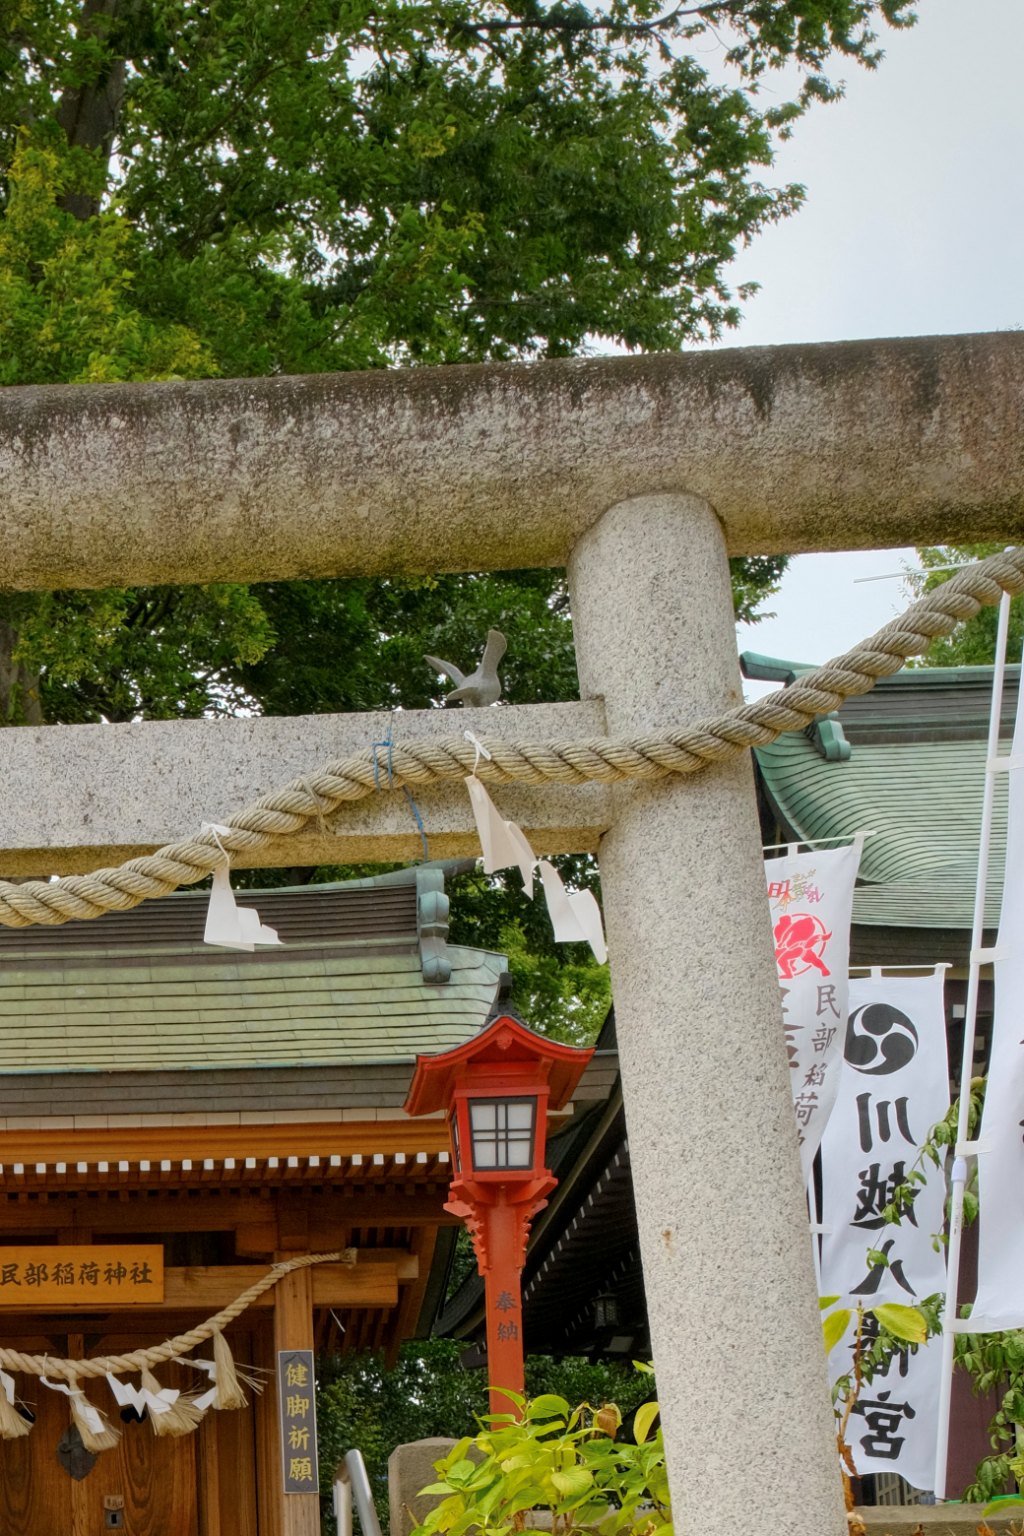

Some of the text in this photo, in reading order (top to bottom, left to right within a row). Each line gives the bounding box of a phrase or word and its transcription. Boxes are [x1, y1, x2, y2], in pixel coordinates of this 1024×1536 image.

[0, 1261, 154, 1288] 民部稲荷神社
[495, 1290, 519, 1343] 奉納
[285, 1363, 314, 1482] 健脚祈願
